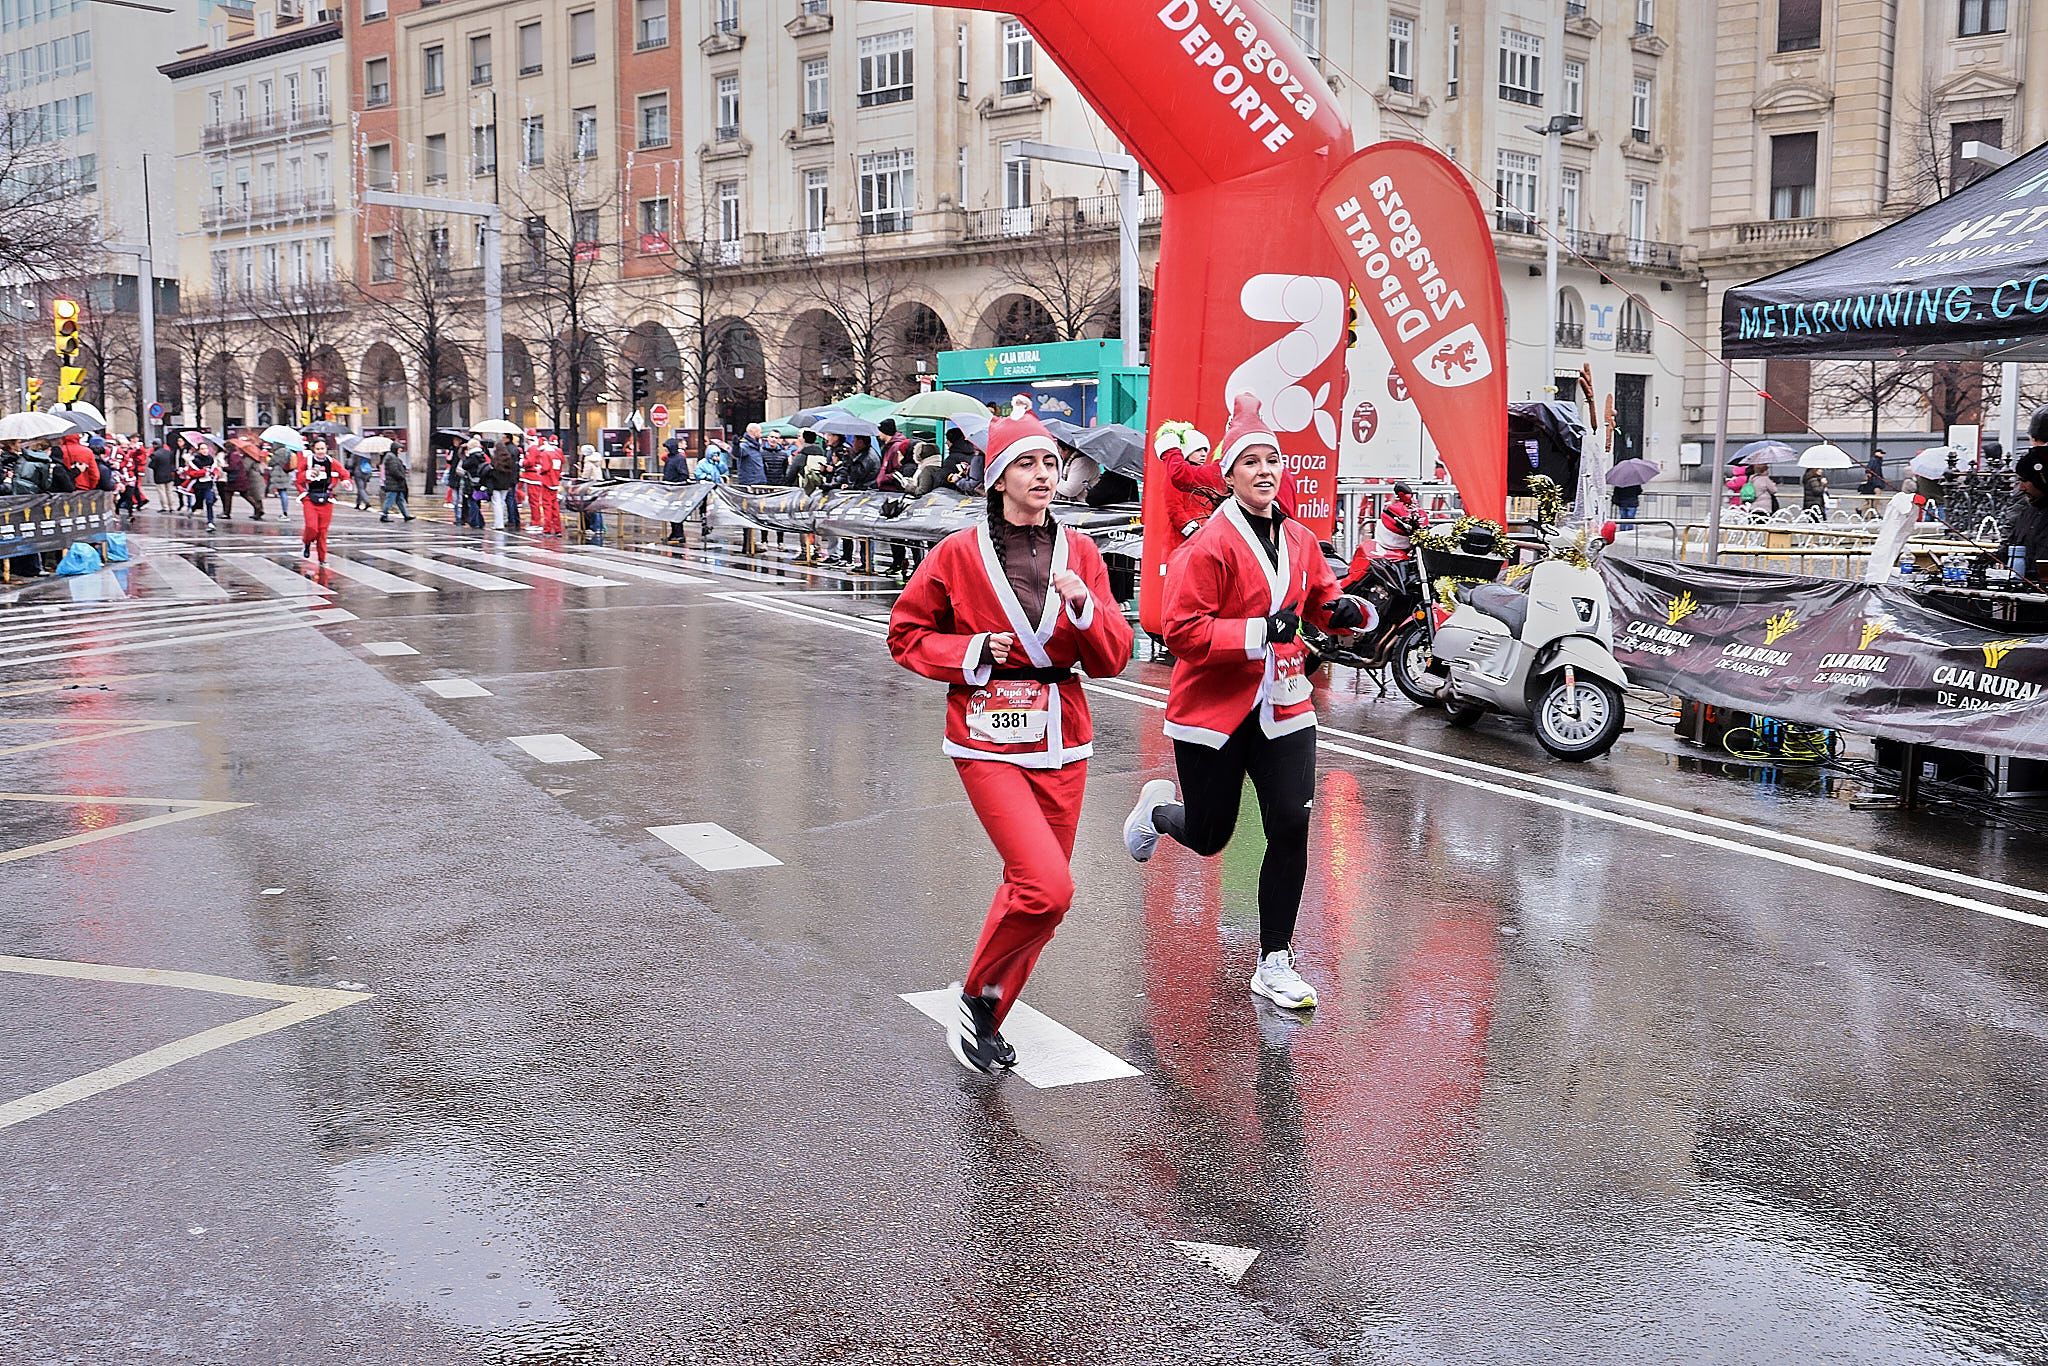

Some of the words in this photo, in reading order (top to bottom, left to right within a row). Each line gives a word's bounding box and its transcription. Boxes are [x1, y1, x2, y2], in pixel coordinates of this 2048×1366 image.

[1157, 0, 1295, 153] DEPORTE
[1890, 239, 2035, 269] RUNNING
[1000, 352, 1017, 364] CAJA
[1003, 366, 1012, 376] DE
[1296, 475, 1318, 494] rte
[1297, 497, 1330, 518] nible
[1626, 620, 1659, 642] CAJA
[1656, 628, 1695, 648] RURAL
[1721, 643, 1754, 661] CAJA
[1751, 649, 1793, 666] RURAL
[1845, 655, 1890, 673] RURAL
[1715, 659, 1732, 670] DE
[1729, 661, 1774, 678] ARAGÓN
[1812, 672, 1827, 684] DE
[1932, 665, 1976, 689] CAJA
[1976, 672, 2043, 701] RURAL
[1936, 690, 1957, 708] DE
[991, 711, 1028, 728] 3381
